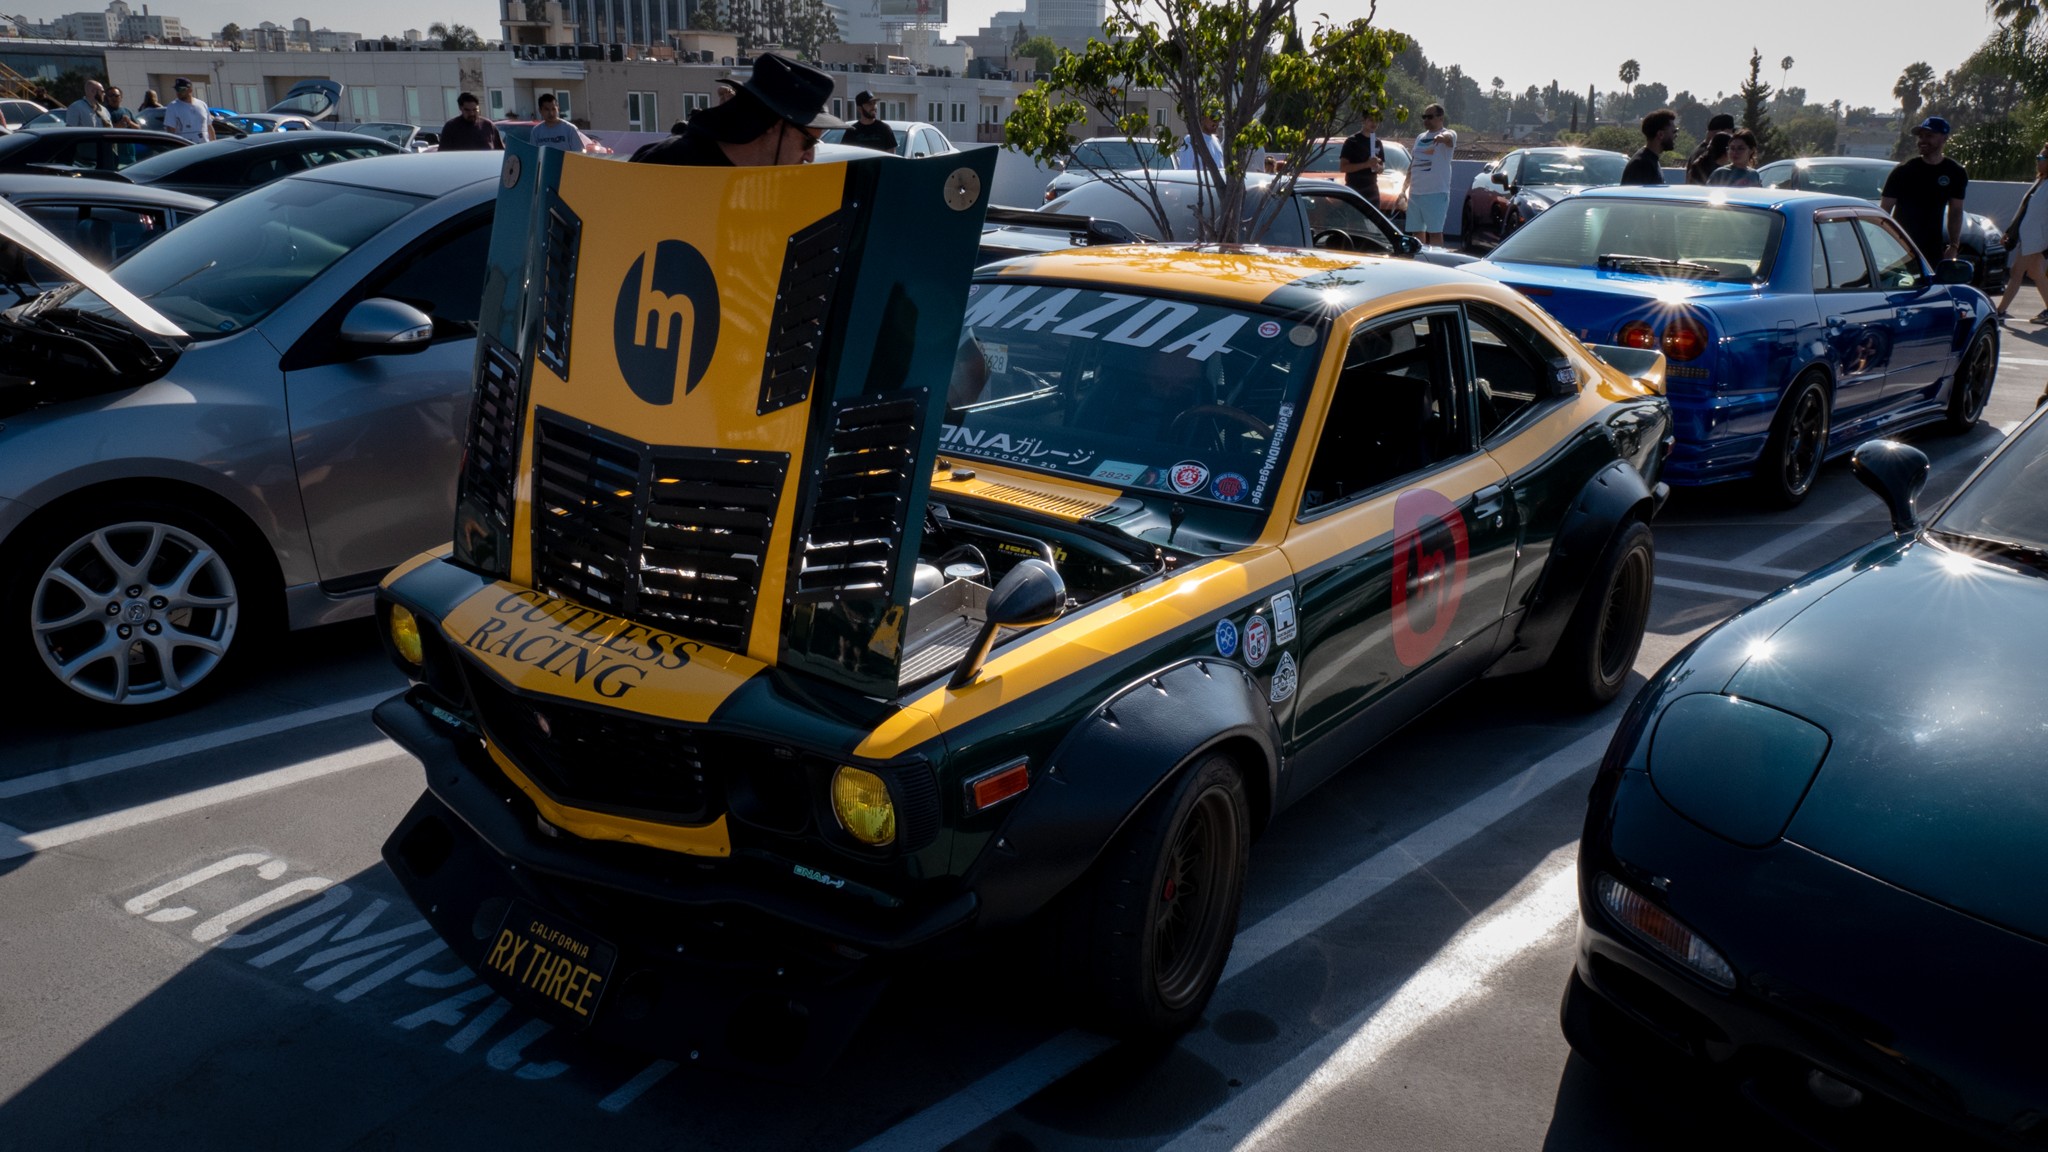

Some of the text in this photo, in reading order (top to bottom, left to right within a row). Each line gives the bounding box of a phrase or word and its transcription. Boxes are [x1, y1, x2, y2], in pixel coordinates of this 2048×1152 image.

[965, 284, 1250, 362] MAZDA
[1039, 461, 1057, 469] 20
[1097, 470, 1134, 481] 2825
[463, 616, 648, 698] RACING
[494, 590, 705, 670] GUTLESS
[487, 928, 603, 1017] RX THREE
[529, 920, 590, 959] CALIFORNIA
